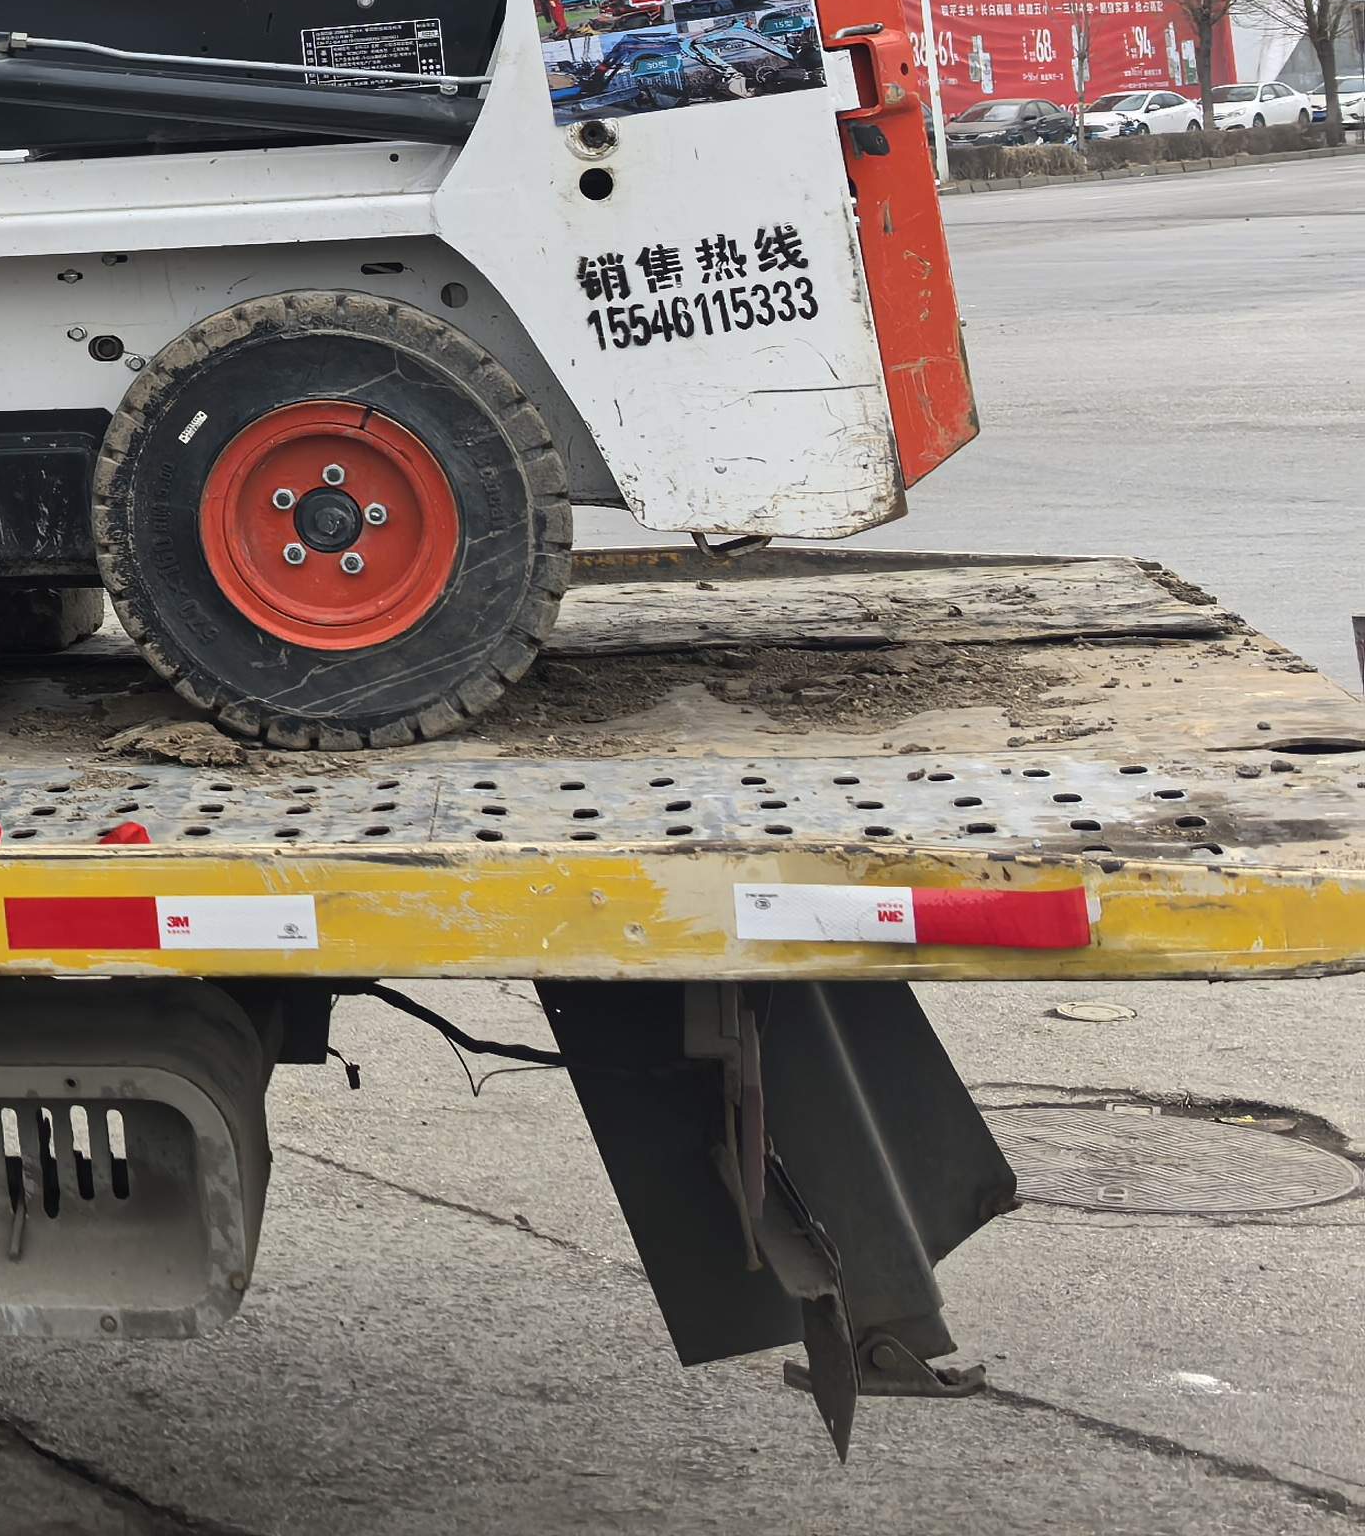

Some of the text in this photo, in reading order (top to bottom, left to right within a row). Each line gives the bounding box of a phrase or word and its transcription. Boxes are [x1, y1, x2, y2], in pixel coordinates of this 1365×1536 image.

[1035, 29, 1052, 62] 68
[576, 225, 809, 302] 销售热线
[587, 276, 819, 351] 15546115333
[167, 916, 191, 928] 3M
